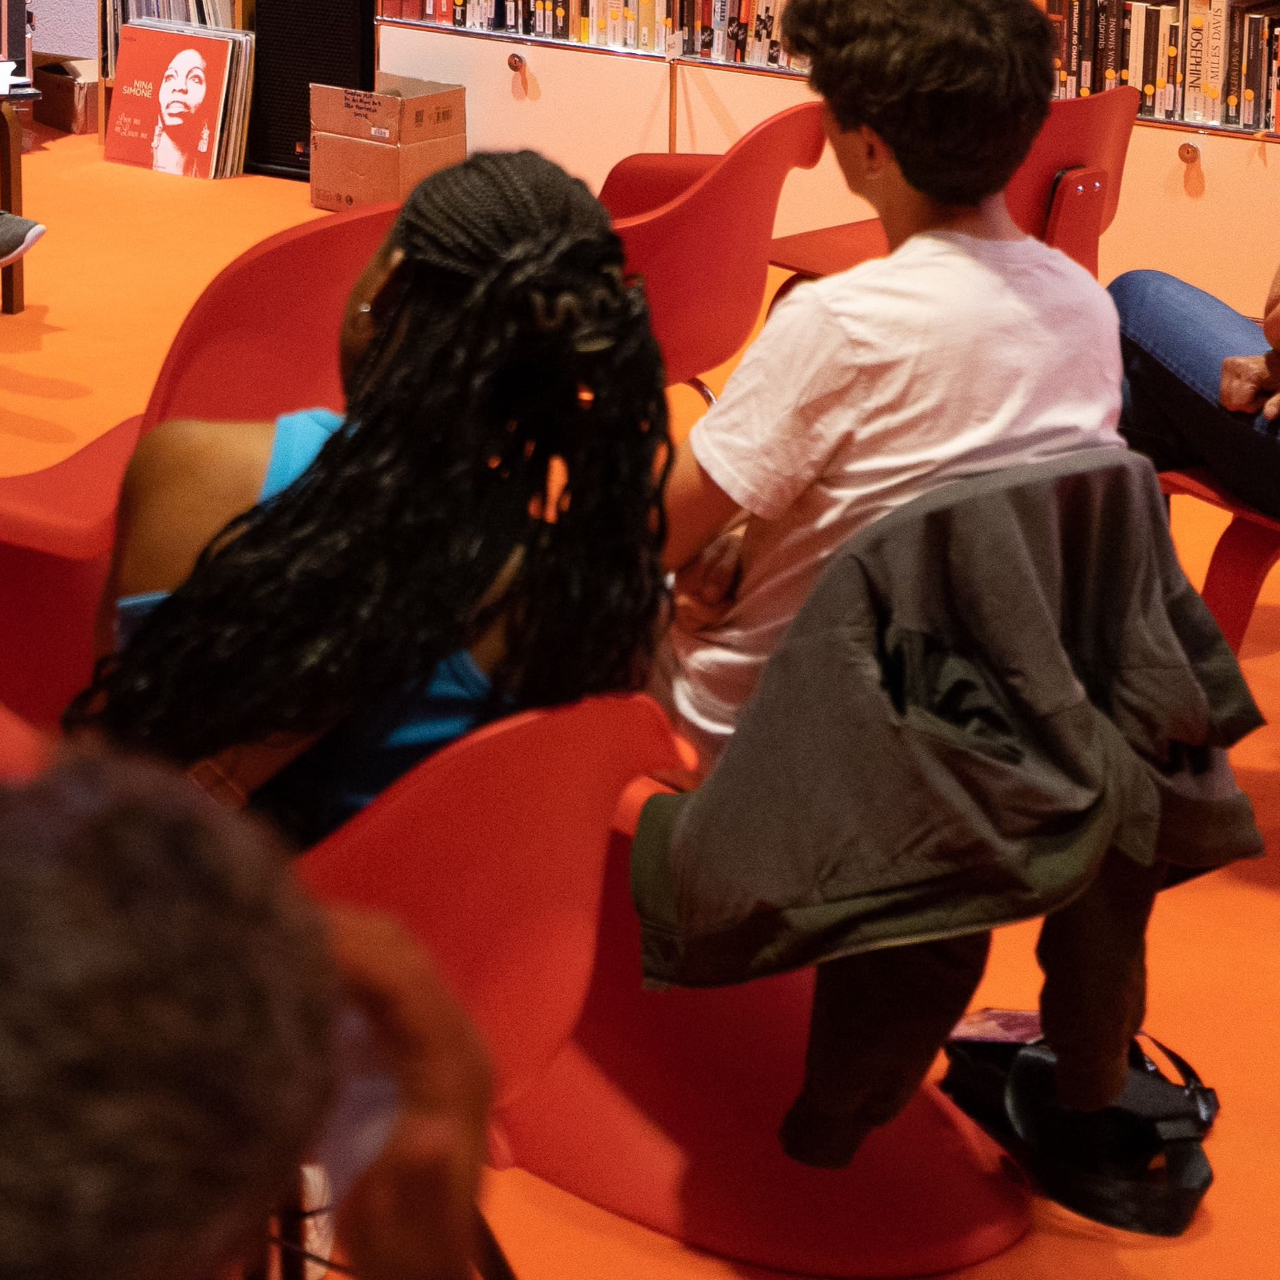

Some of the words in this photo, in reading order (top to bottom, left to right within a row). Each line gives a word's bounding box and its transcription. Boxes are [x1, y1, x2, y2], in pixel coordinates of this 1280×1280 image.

[1108, 17, 1117, 50] SIMONE
[1212, 8, 1222, 41] DAVIS
[1072, 34, 1078, 44] NO
[1189, 27, 1203, 92] JOSEPHINE
[1211, 45, 1220, 81] MILES
[122, 85, 152, 99] SIMONE
[133, 79, 153, 91] NINA
[117, 113, 132, 126] Love
